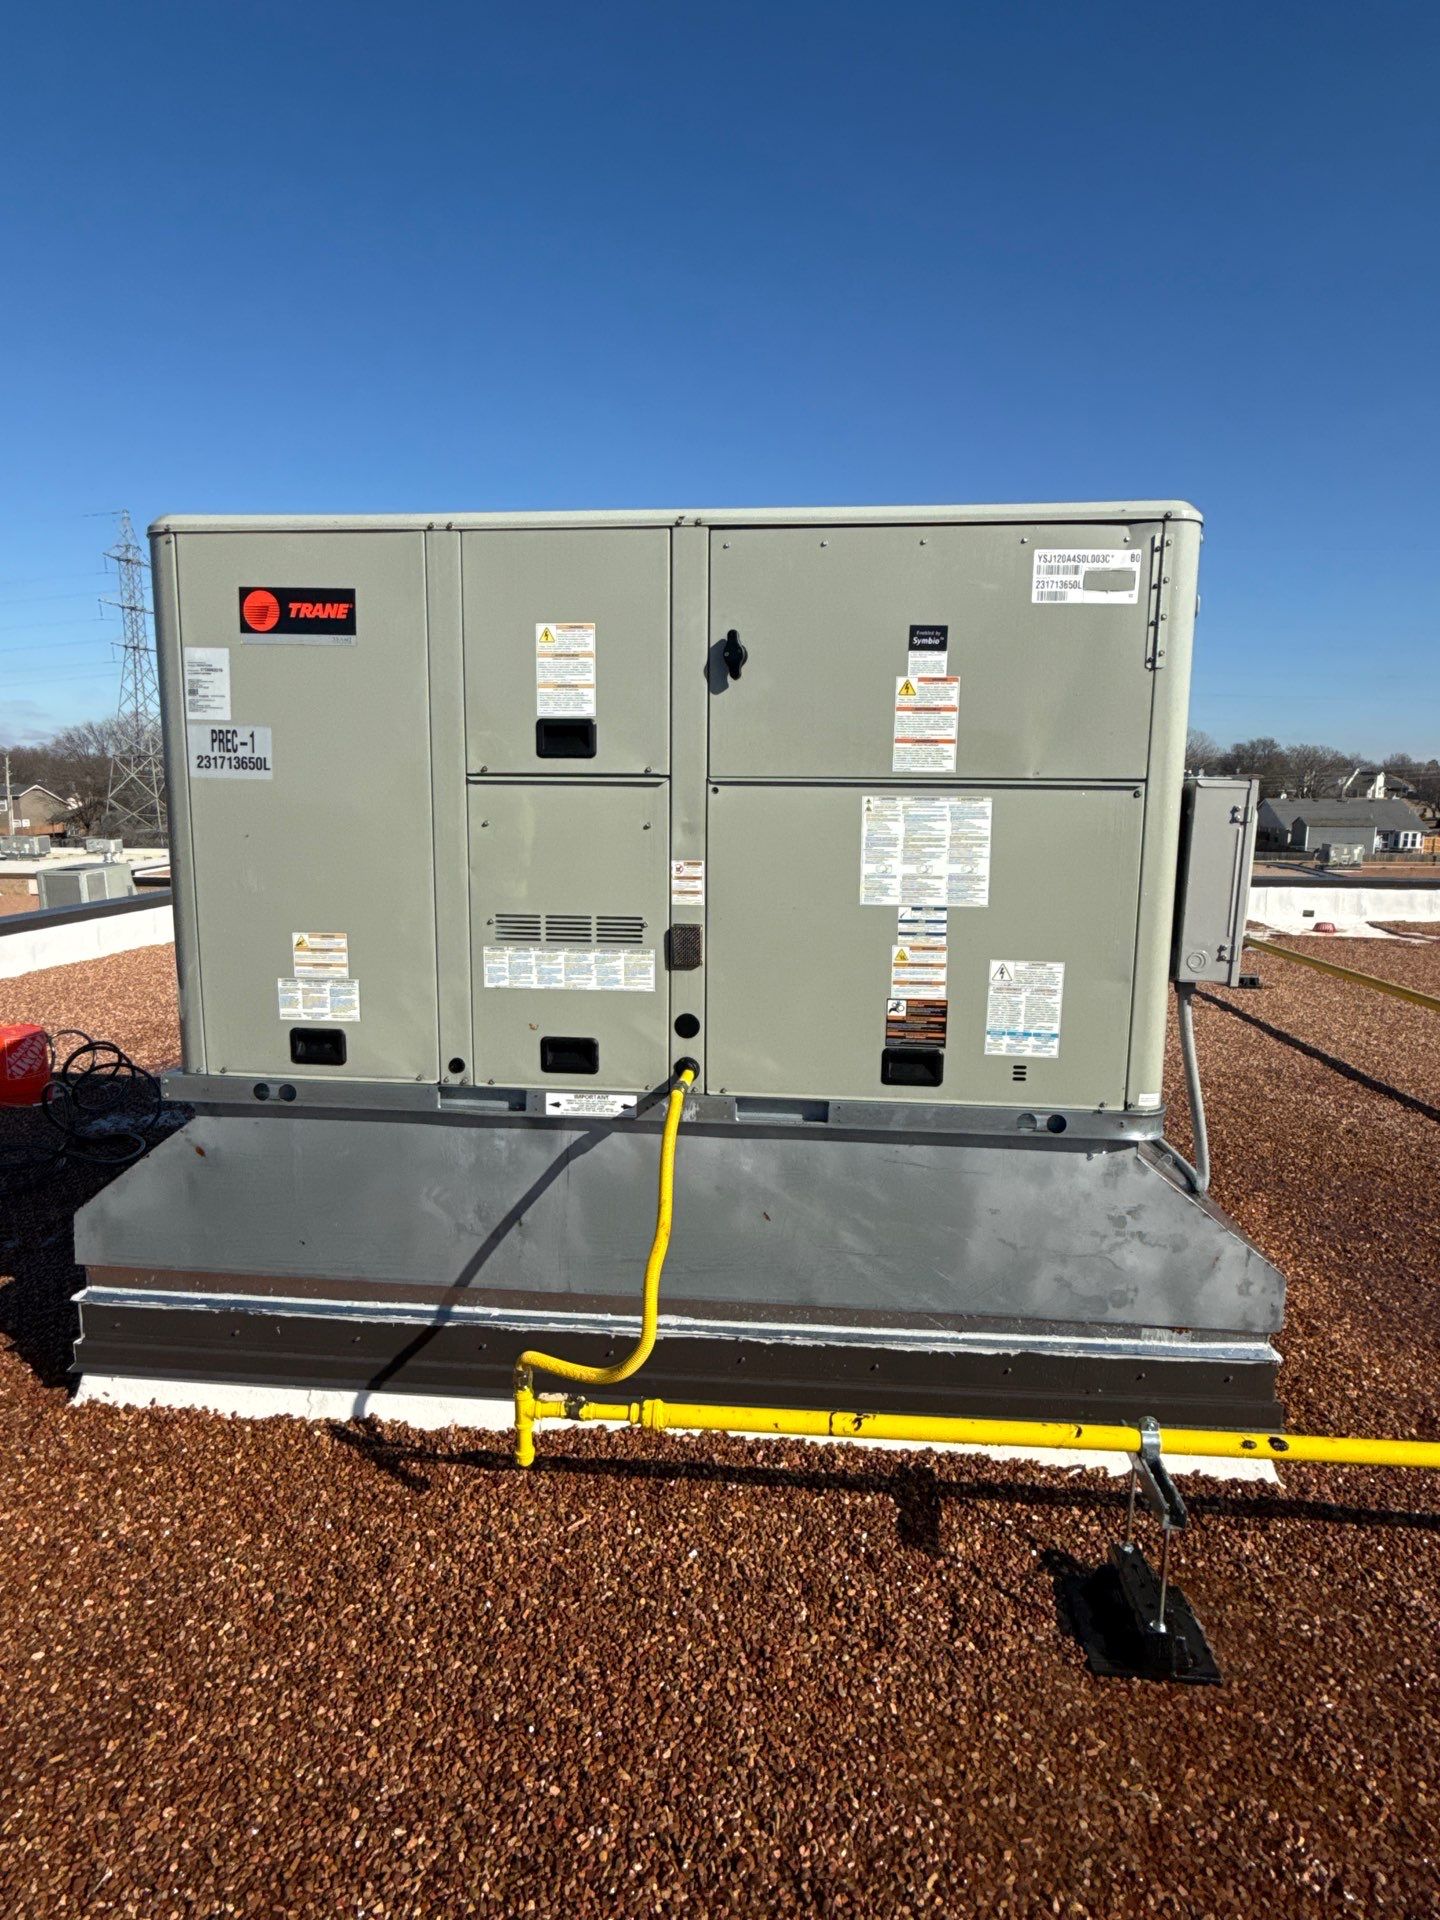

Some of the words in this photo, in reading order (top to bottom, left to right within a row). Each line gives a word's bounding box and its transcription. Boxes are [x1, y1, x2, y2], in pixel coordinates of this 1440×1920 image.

[1035, 580, 1082, 589] 231713650L
[288, 602, 351, 619] TRANE
[210, 728, 256, 754] PREC-1
[196, 754, 271, 771] 231713650L
